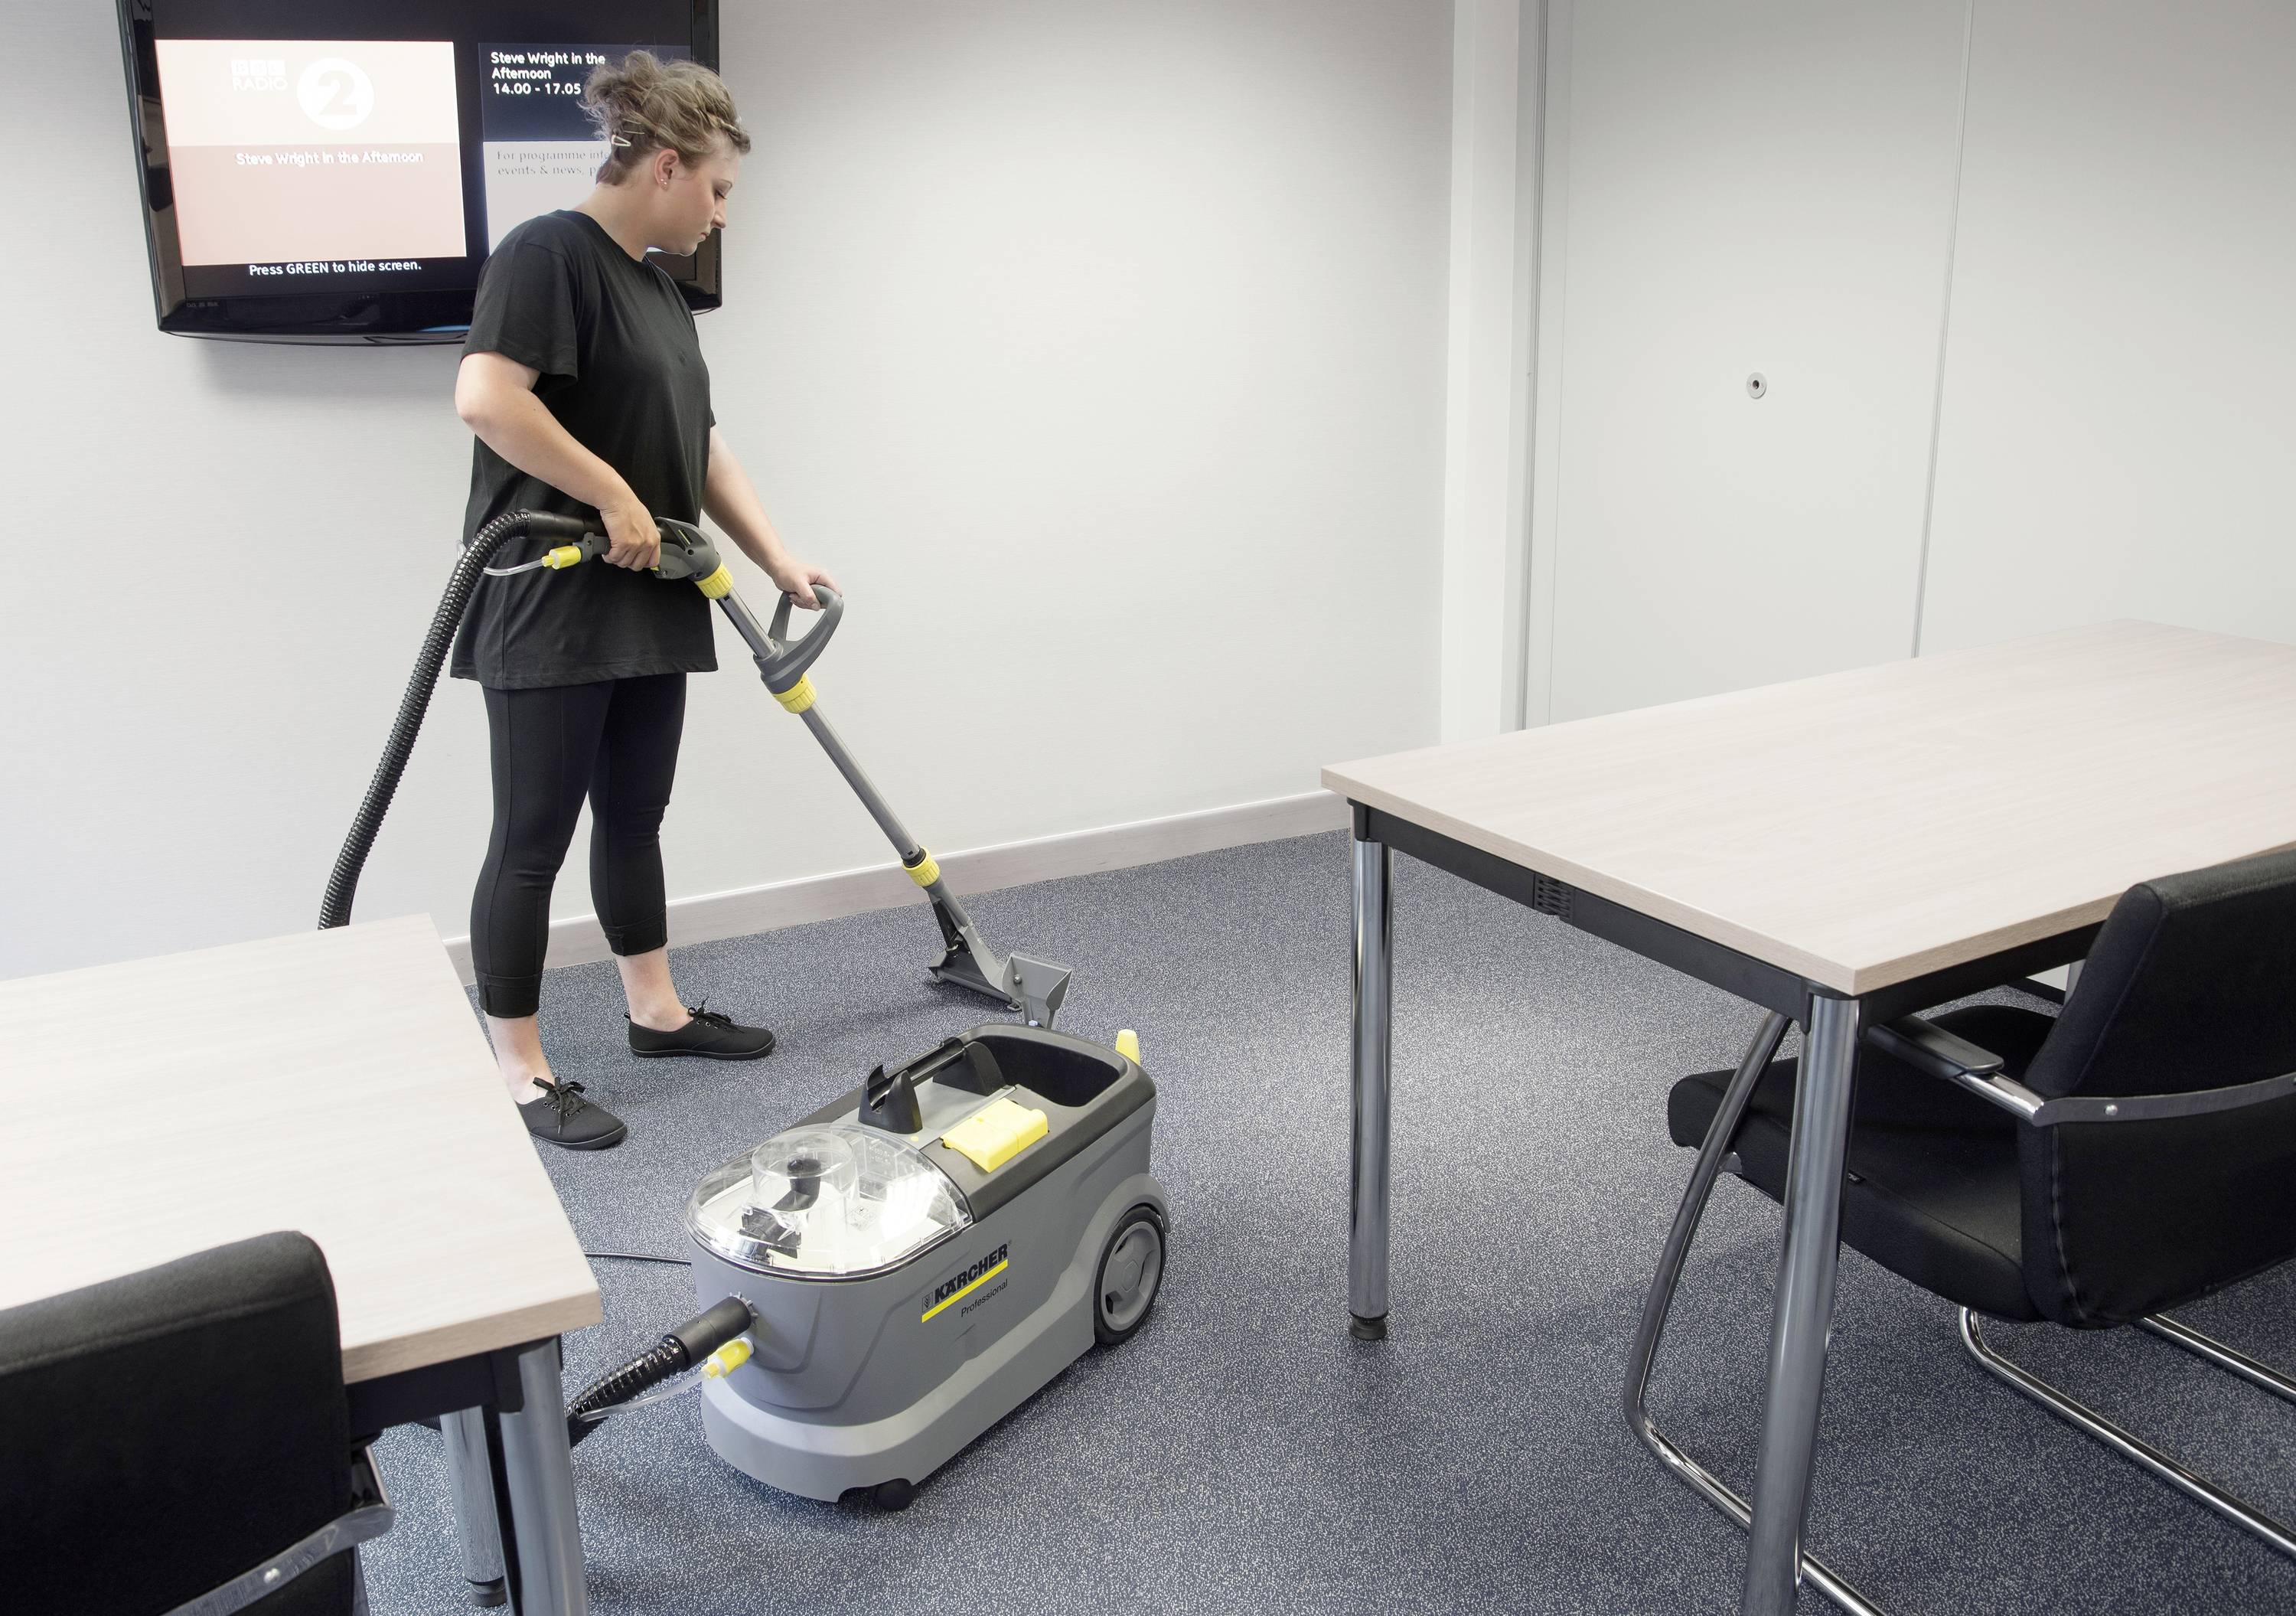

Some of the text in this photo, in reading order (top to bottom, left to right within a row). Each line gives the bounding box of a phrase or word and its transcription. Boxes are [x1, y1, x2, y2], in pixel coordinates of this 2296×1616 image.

[491, 51, 606, 67] Steve Wright in the
[491, 67, 552, 80] Afternoon
[232, 77, 289, 90] RADIO
[493, 82, 531, 95] 14.00
[544, 82, 582, 95] 17.05
[318, 70, 357, 115] 2
[235, 151, 424, 168] Steve Wright in the Afternoon
[497, 151, 514, 160] For
[520, 152, 586, 163] programme
[497, 165, 536, 175] events
[540, 165, 549, 175] &
[249, 260, 422, 276] Press GREEN to hide screen.
[934, 1243, 1008, 1304] KÄRCHER
[960, 1278, 1008, 1317] Professional
